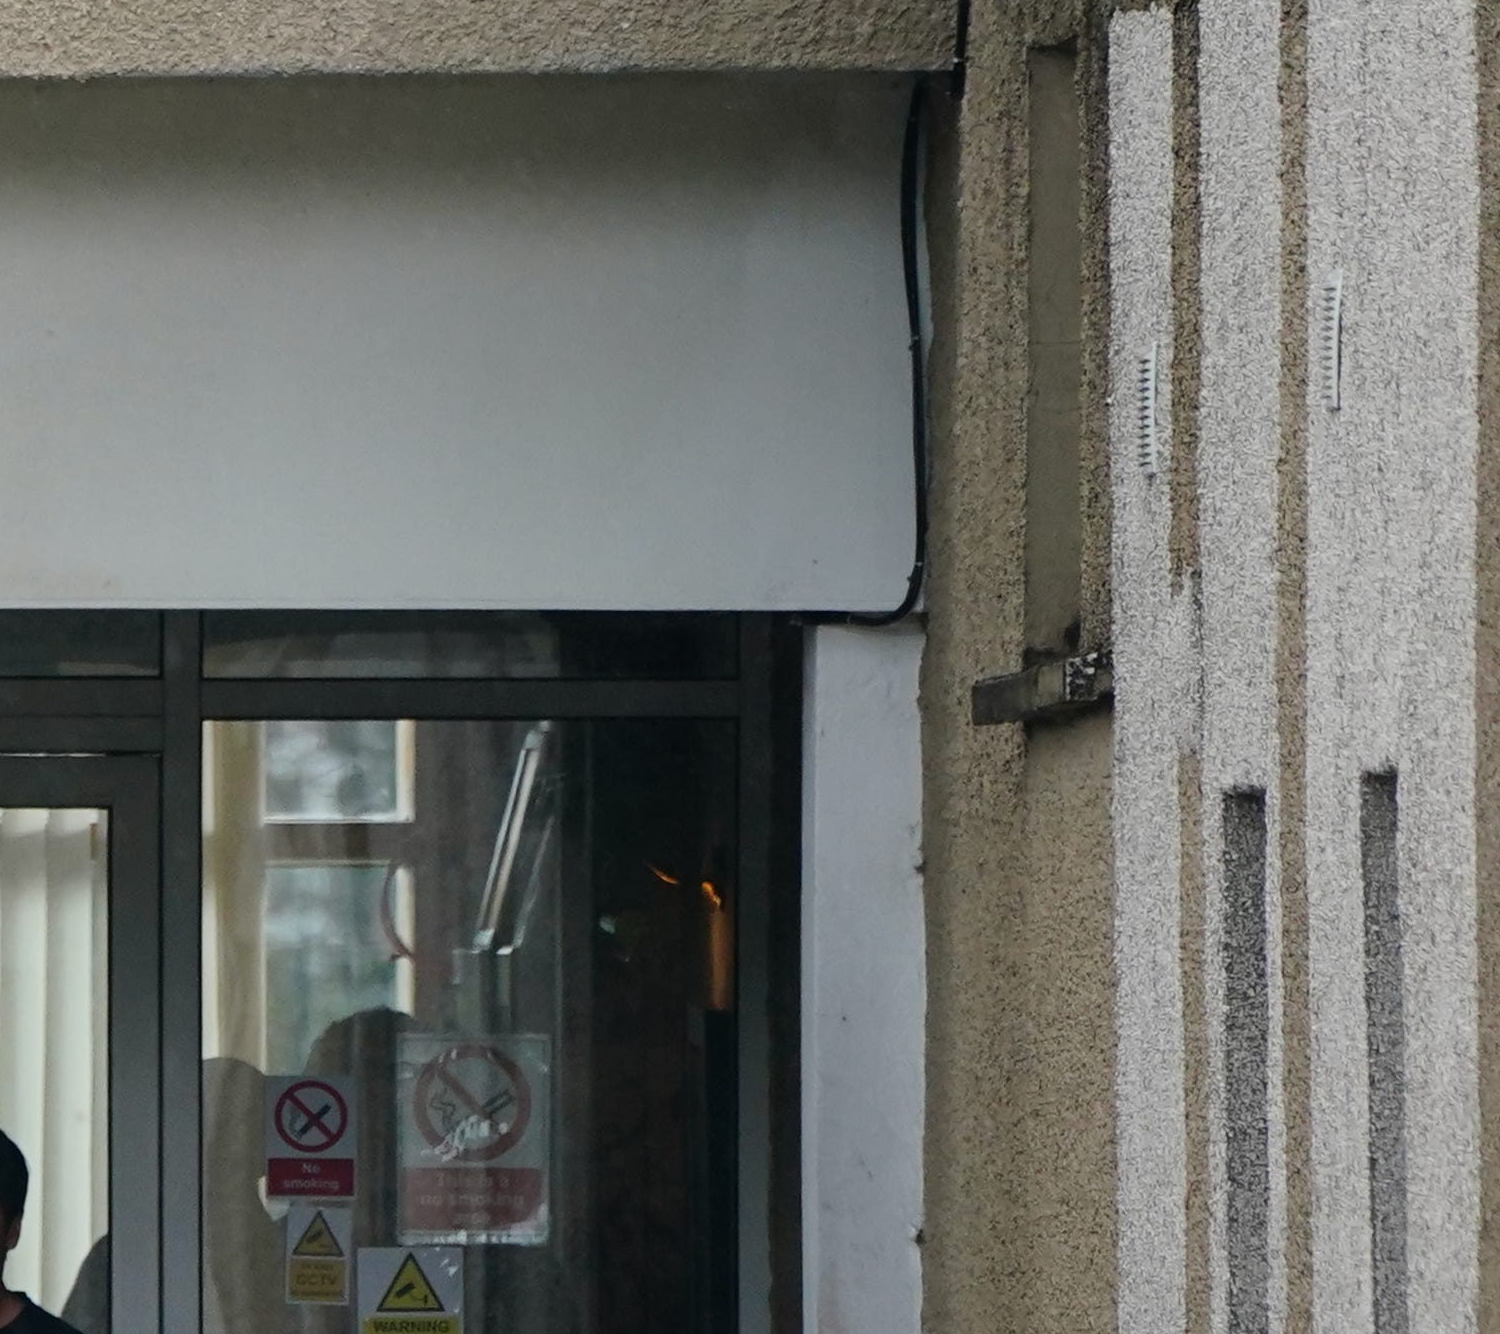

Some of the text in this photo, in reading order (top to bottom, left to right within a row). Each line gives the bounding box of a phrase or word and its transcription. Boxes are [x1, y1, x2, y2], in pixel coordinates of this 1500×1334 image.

[301, 1163, 321, 1174] No
[283, 1178, 340, 1192] smoking
[296, 1274, 338, 1286] CCTV
[373, 1320, 450, 1333] WARNING
